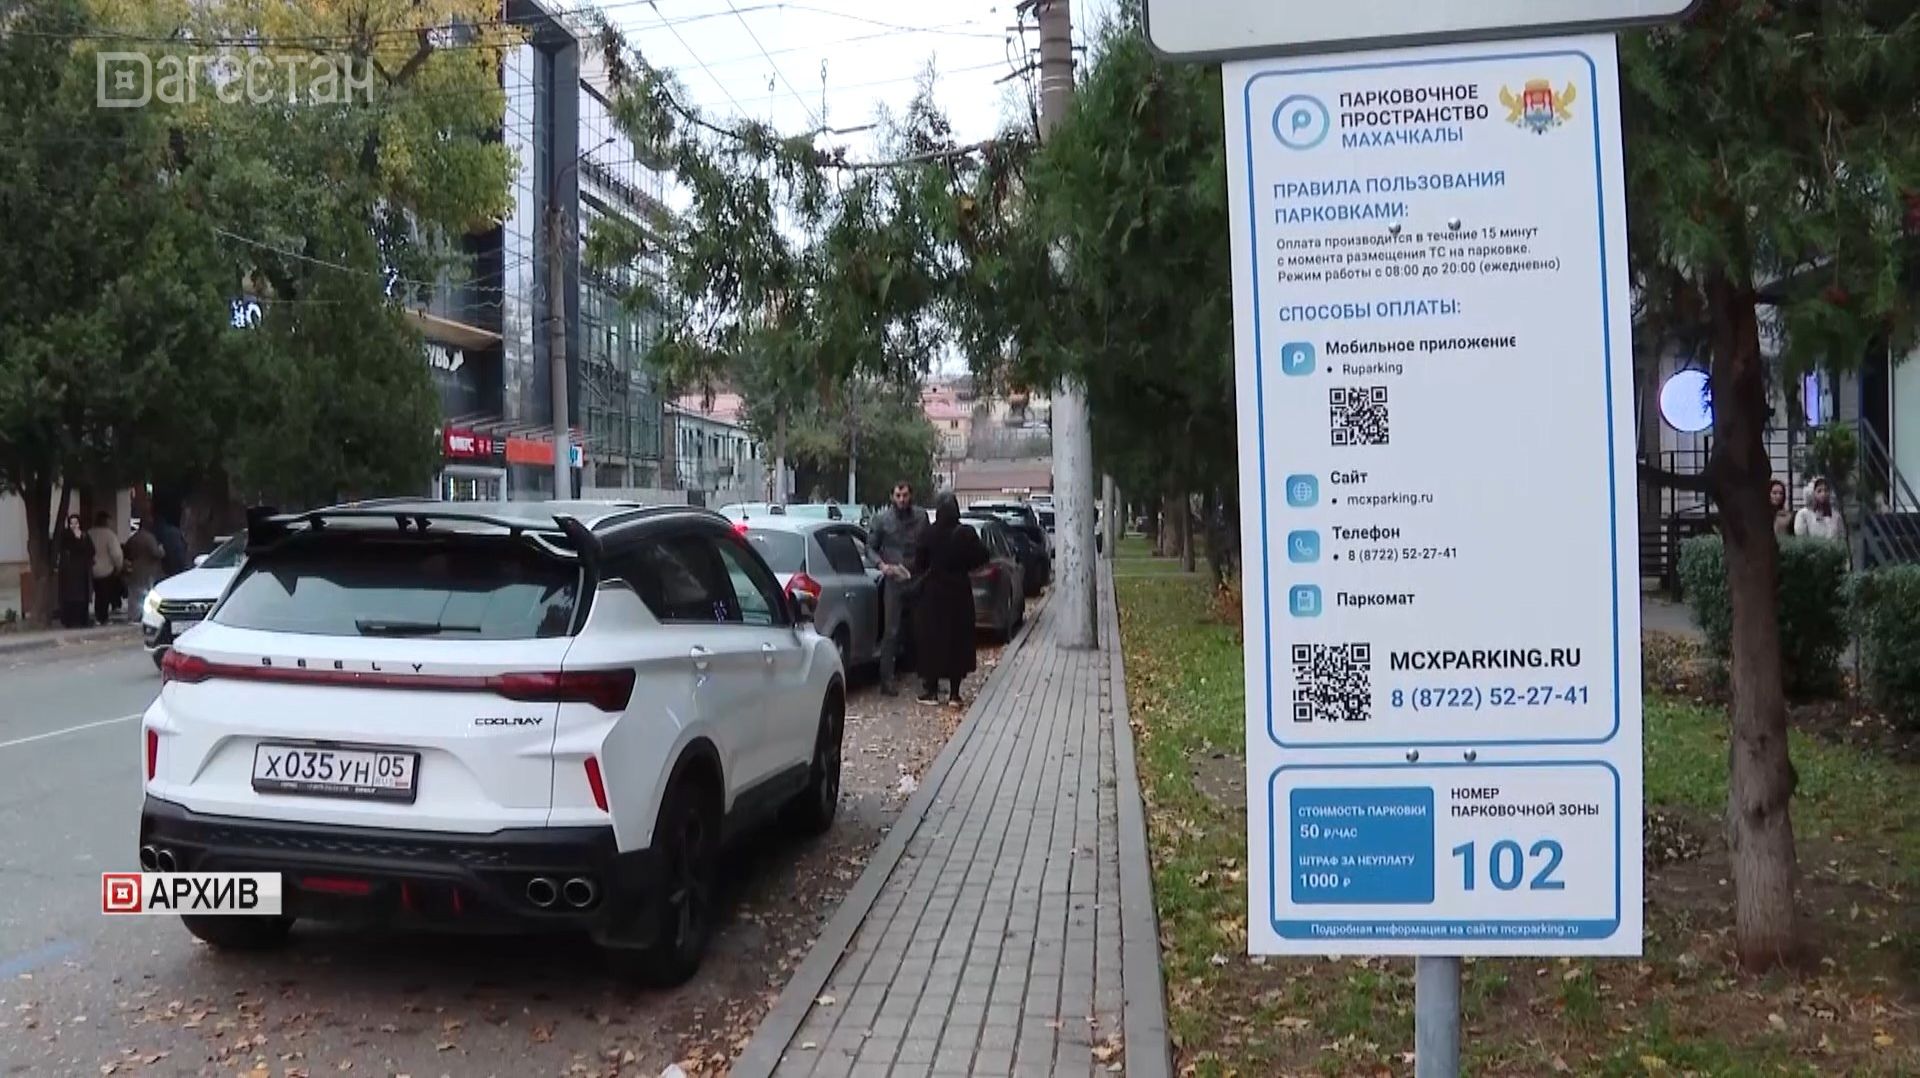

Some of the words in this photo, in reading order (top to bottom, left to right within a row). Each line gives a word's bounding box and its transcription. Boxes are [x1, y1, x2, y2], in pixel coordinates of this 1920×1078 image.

[1340, 84, 1478, 107] ПАРКОВОЧНОЕ
[1341, 104, 1489, 127] ПРОСТРАНСТВО
[1342, 126, 1463, 148] МАХАЧКАЛЫ
[1274, 178, 1361, 199] ПРАВИЛА
[1366, 171, 1506, 194] ПОЛЬЗОВАНИЯ
[1275, 202, 1409, 224] ПАРКОВКАМИ:
[1276, 238, 1322, 251] Оплата
[1325, 232, 1413, 249] производится
[1416, 234, 1424, 244] в
[1426, 229, 1478, 242] течение
[1481, 227, 1497, 240] 15
[1499, 226, 1539, 240] минут
[1277, 257, 1285, 266] с
[1287, 252, 1343, 266] момента
[1346, 248, 1426, 265] размещения
[1429, 245, 1446, 258] ТС
[1449, 247, 1465, 258] на
[1467, 243, 1532, 258] парковке.
[1278, 269, 1322, 283] Режим
[1325, 266, 1372, 283] работы
[1375, 267, 1382, 278] с
[1384, 264, 1420, 278] 08:00
[1422, 264, 1439, 277] до
[1441, 261, 1476, 275] 20:00
[1479, 258, 1561, 275] (ежедневно)
[1279, 302, 1372, 323] СПОСОБЫ
[1375, 298, 1462, 319] ОПЛАТЫ:
[1325, 340, 1416, 356] Мобильное
[1419, 335, 1517, 354] приложение
[1342, 362, 1403, 377] Ruparking
[1330, 470, 1368, 485] Сайт
[1347, 491, 1434, 508] mcxparking.ru
[1332, 525, 1400, 543] Телефон
[1348, 550, 1356, 562] 8
[1359, 548, 1399, 564] (8722)
[1402, 547, 1457, 561] 52-27-41
[1336, 592, 1415, 609] Паркомат
[1389, 647, 1582, 671] MCXPARKING.RU
[1391, 689, 1404, 708] 8
[1411, 686, 1482, 712] (8722)
[1489, 685, 1589, 707] 52-27-41
[378, 755, 405, 778] 05
[1450, 787, 1500, 800] НОМЕР
[1298, 804, 1366, 818] СТОИМОСТЬ
[1367, 804, 1427, 818] ПАРКОВКИ
[1450, 802, 1556, 818] ПАРКОВОЧНОЙ
[1559, 803, 1600, 817] ЗОНЫ
[1299, 823, 1320, 839] 50
[1298, 854, 1339, 867] ШТРАФ
[1341, 854, 1356, 867] ЗА
[1357, 854, 1415, 867] НЕУПЛАТУ
[1451, 838, 1566, 892] 102
[1299, 873, 1339, 888] 1000
[1311, 922, 1374, 938] Подробная
[1375, 922, 1448, 939] информация
[1450, 924, 1464, 935] на
[1466, 923, 1498, 936] сайте
[1500, 921, 1579, 938] mcxparking.ru
